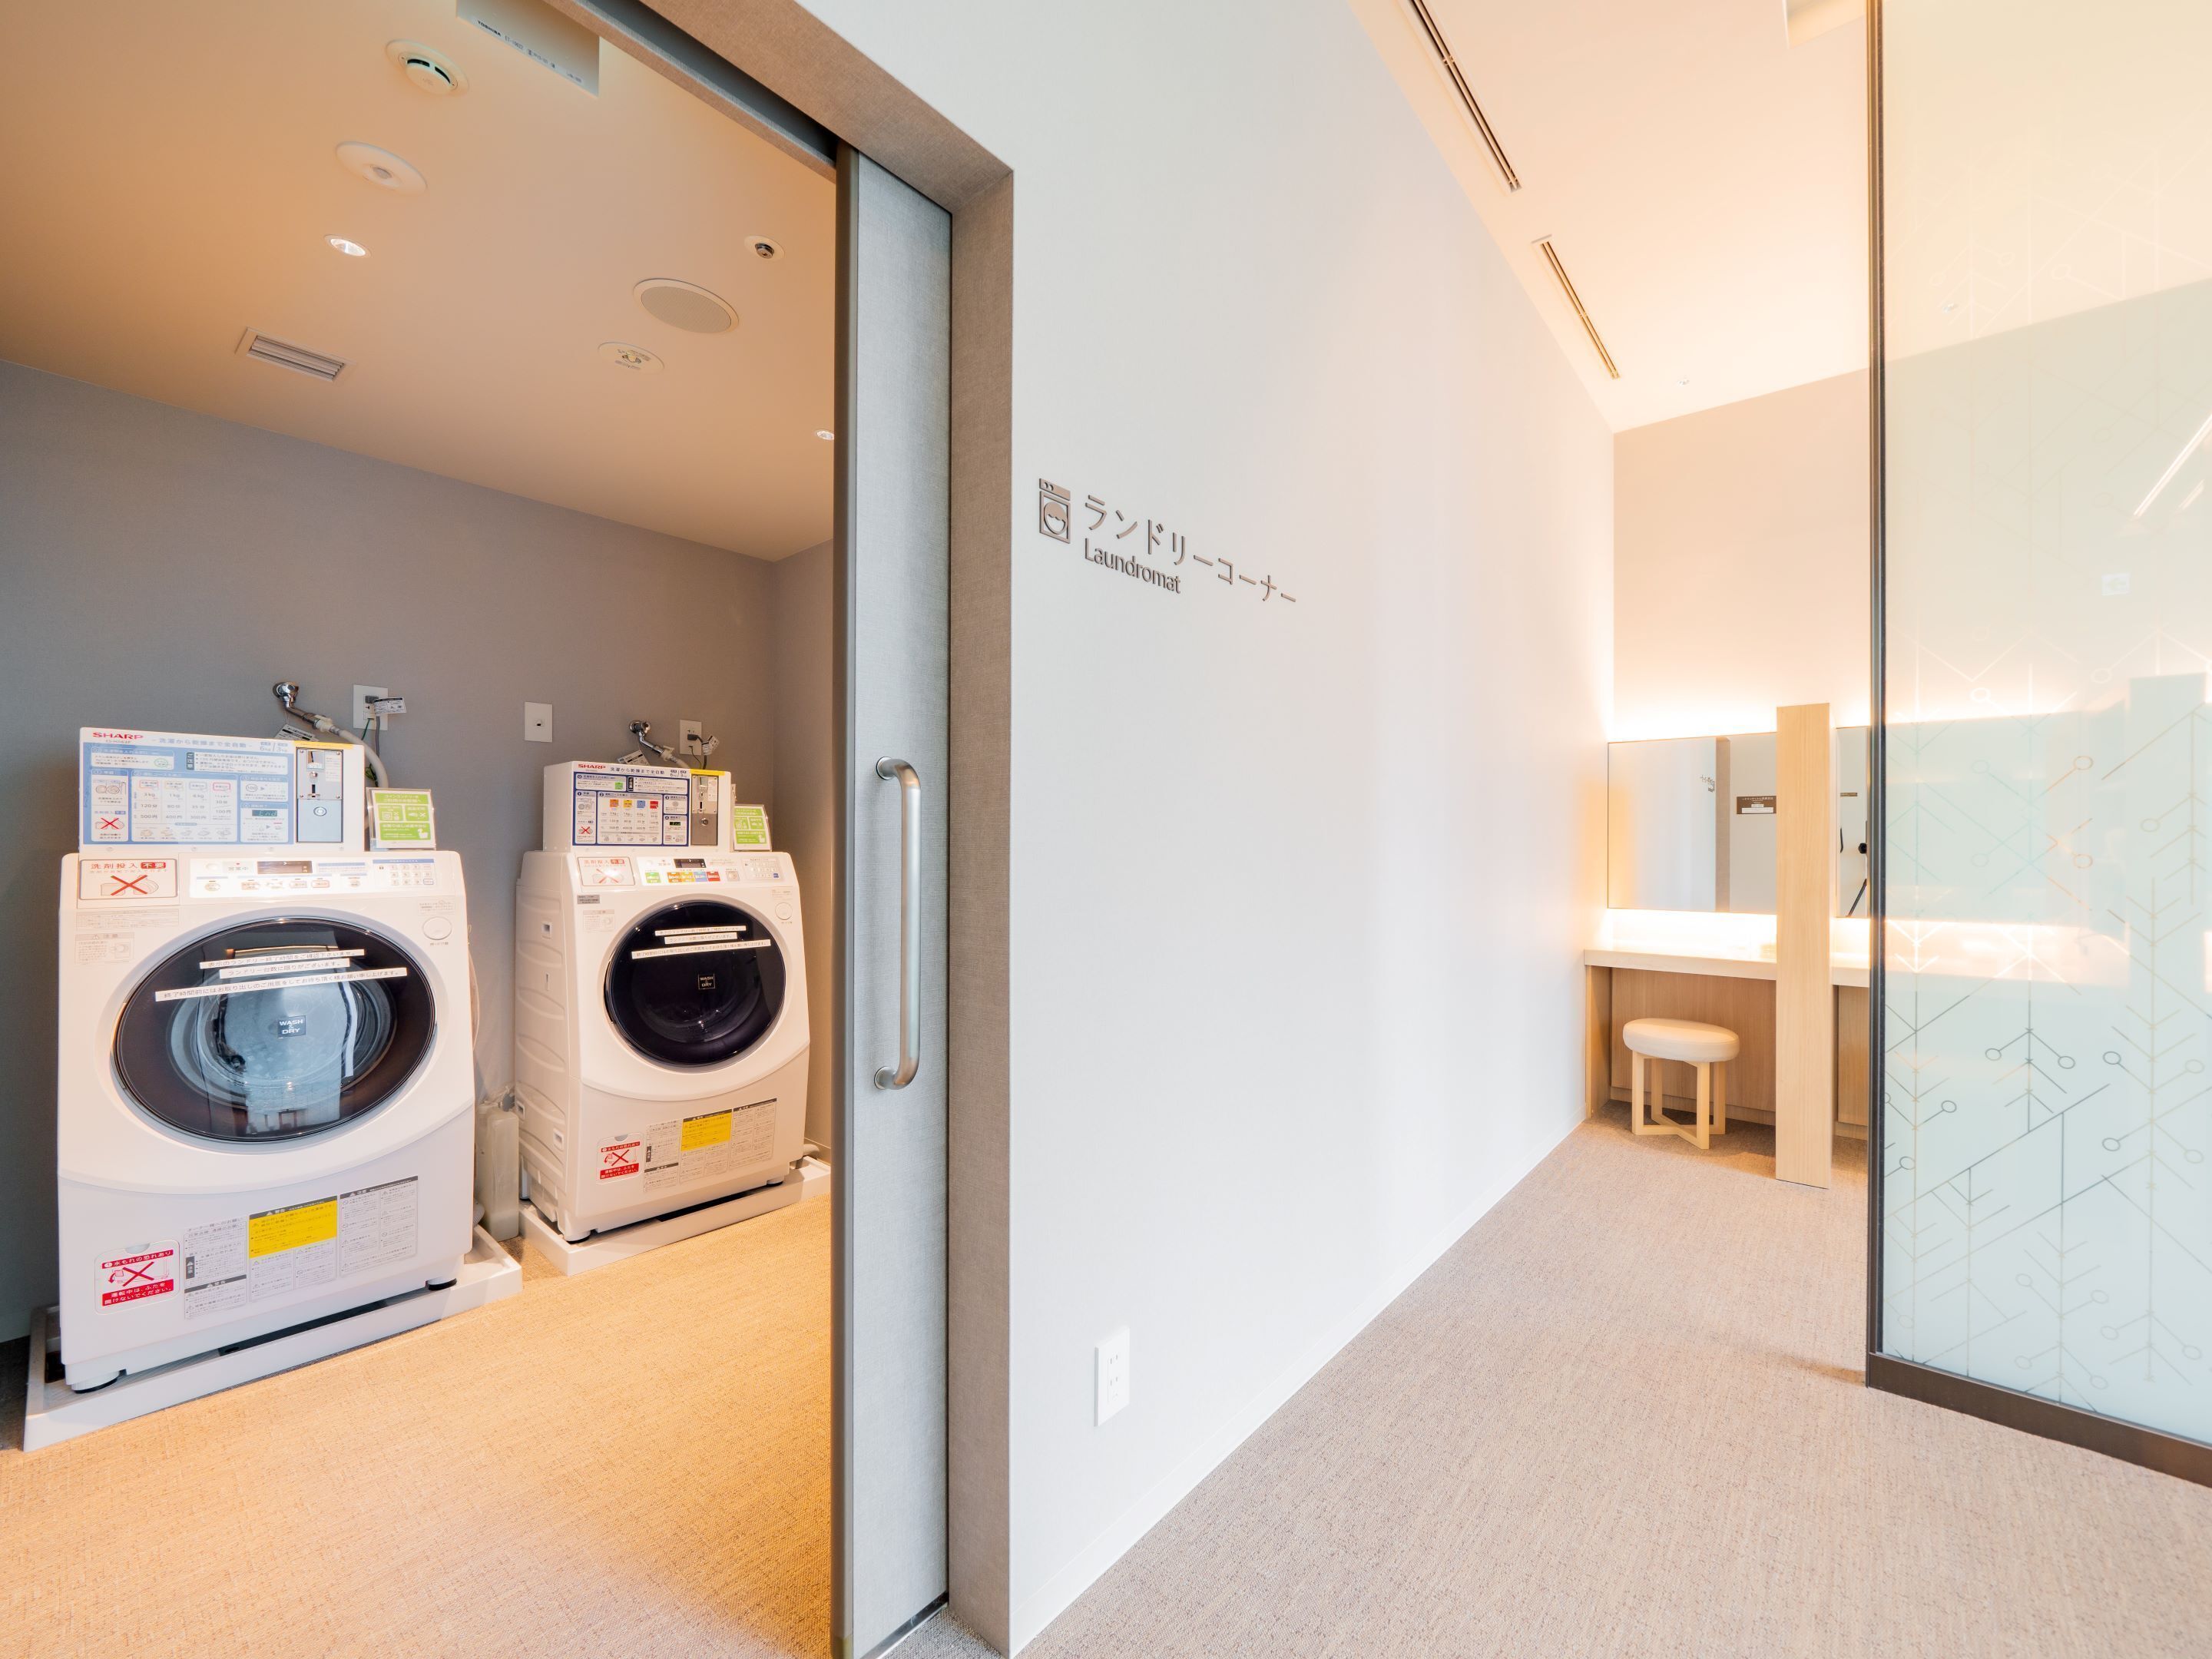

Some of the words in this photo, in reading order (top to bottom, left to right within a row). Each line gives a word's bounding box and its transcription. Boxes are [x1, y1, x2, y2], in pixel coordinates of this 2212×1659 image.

[478, 20, 502, 36] TOSHIBA
[1084, 494, 1296, 602] ランドリーコーナー
[1084, 538, 1181, 594] Laundromat
[114, 1250, 171, 1266] 水もれの恐れあり
[104, 1287, 171, 1305] 開けないでください。
[111, 1283, 166, 1297] 運転中は、ふたを
